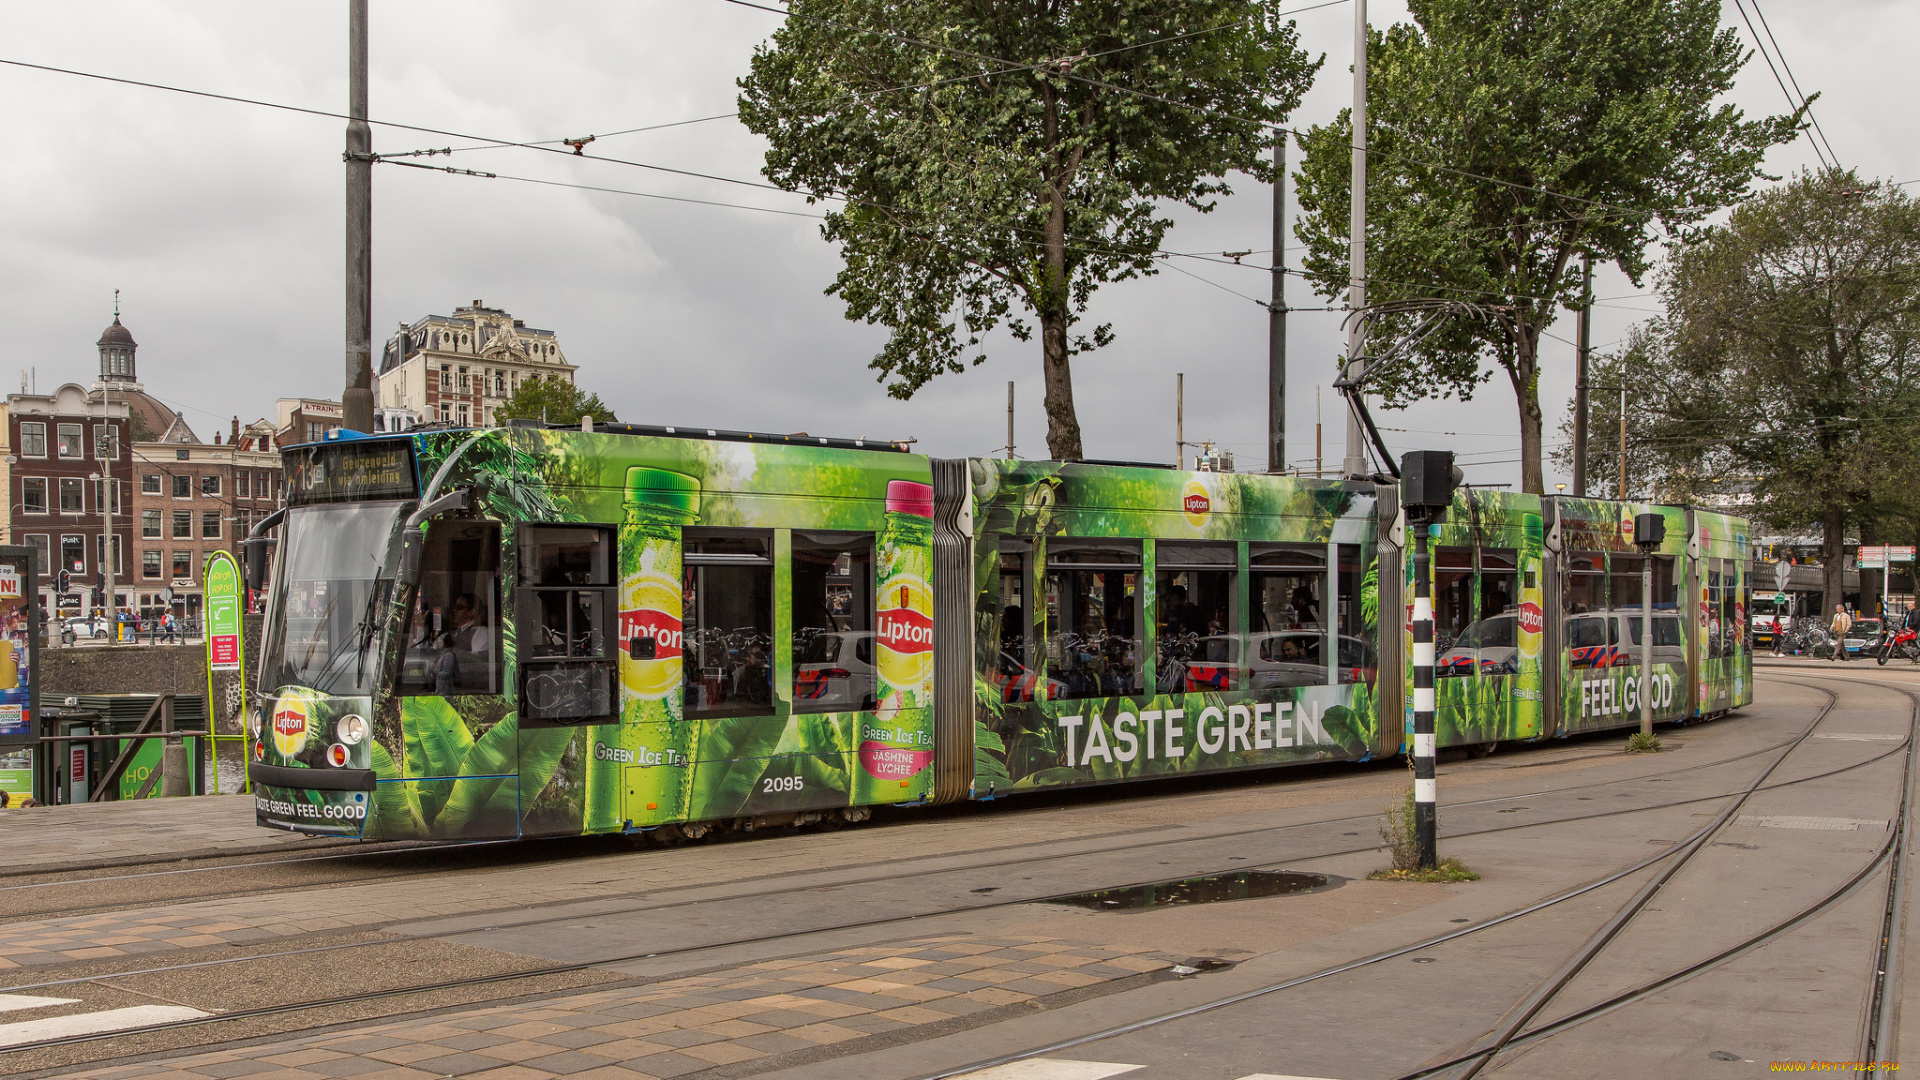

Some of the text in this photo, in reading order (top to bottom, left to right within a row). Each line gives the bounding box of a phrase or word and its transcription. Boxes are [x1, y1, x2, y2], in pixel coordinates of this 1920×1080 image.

[342, 452, 396, 470] Geuzenveld
[338, 469, 400, 486] via omleiding
[1186, 498, 1208, 511] Lipton
[211, 570, 232, 581] HOP ON
[211, 583, 233, 593] HOP OFF
[1518, 607, 1543, 627] Lipton
[877, 616, 933, 645] Lipton
[1581, 678, 1620, 717] FEEL
[276, 716, 302, 731] Lipton
[862, 723, 933, 746] GREEN ICE TEA
[1058, 700, 1319, 767] TASTE GREEN
[594, 741, 635, 763] GREEN
[637, 746, 663, 765] ICE
[872, 750, 914, 764] JASMINE
[126, 766, 154, 784] HO
[877, 763, 911, 775] LYCHEE
[763, 776, 804, 793] 2095
[270, 800, 296, 816] GREEN
[296, 803, 322, 818] FEEL
[323, 805, 366, 819] GOOD
